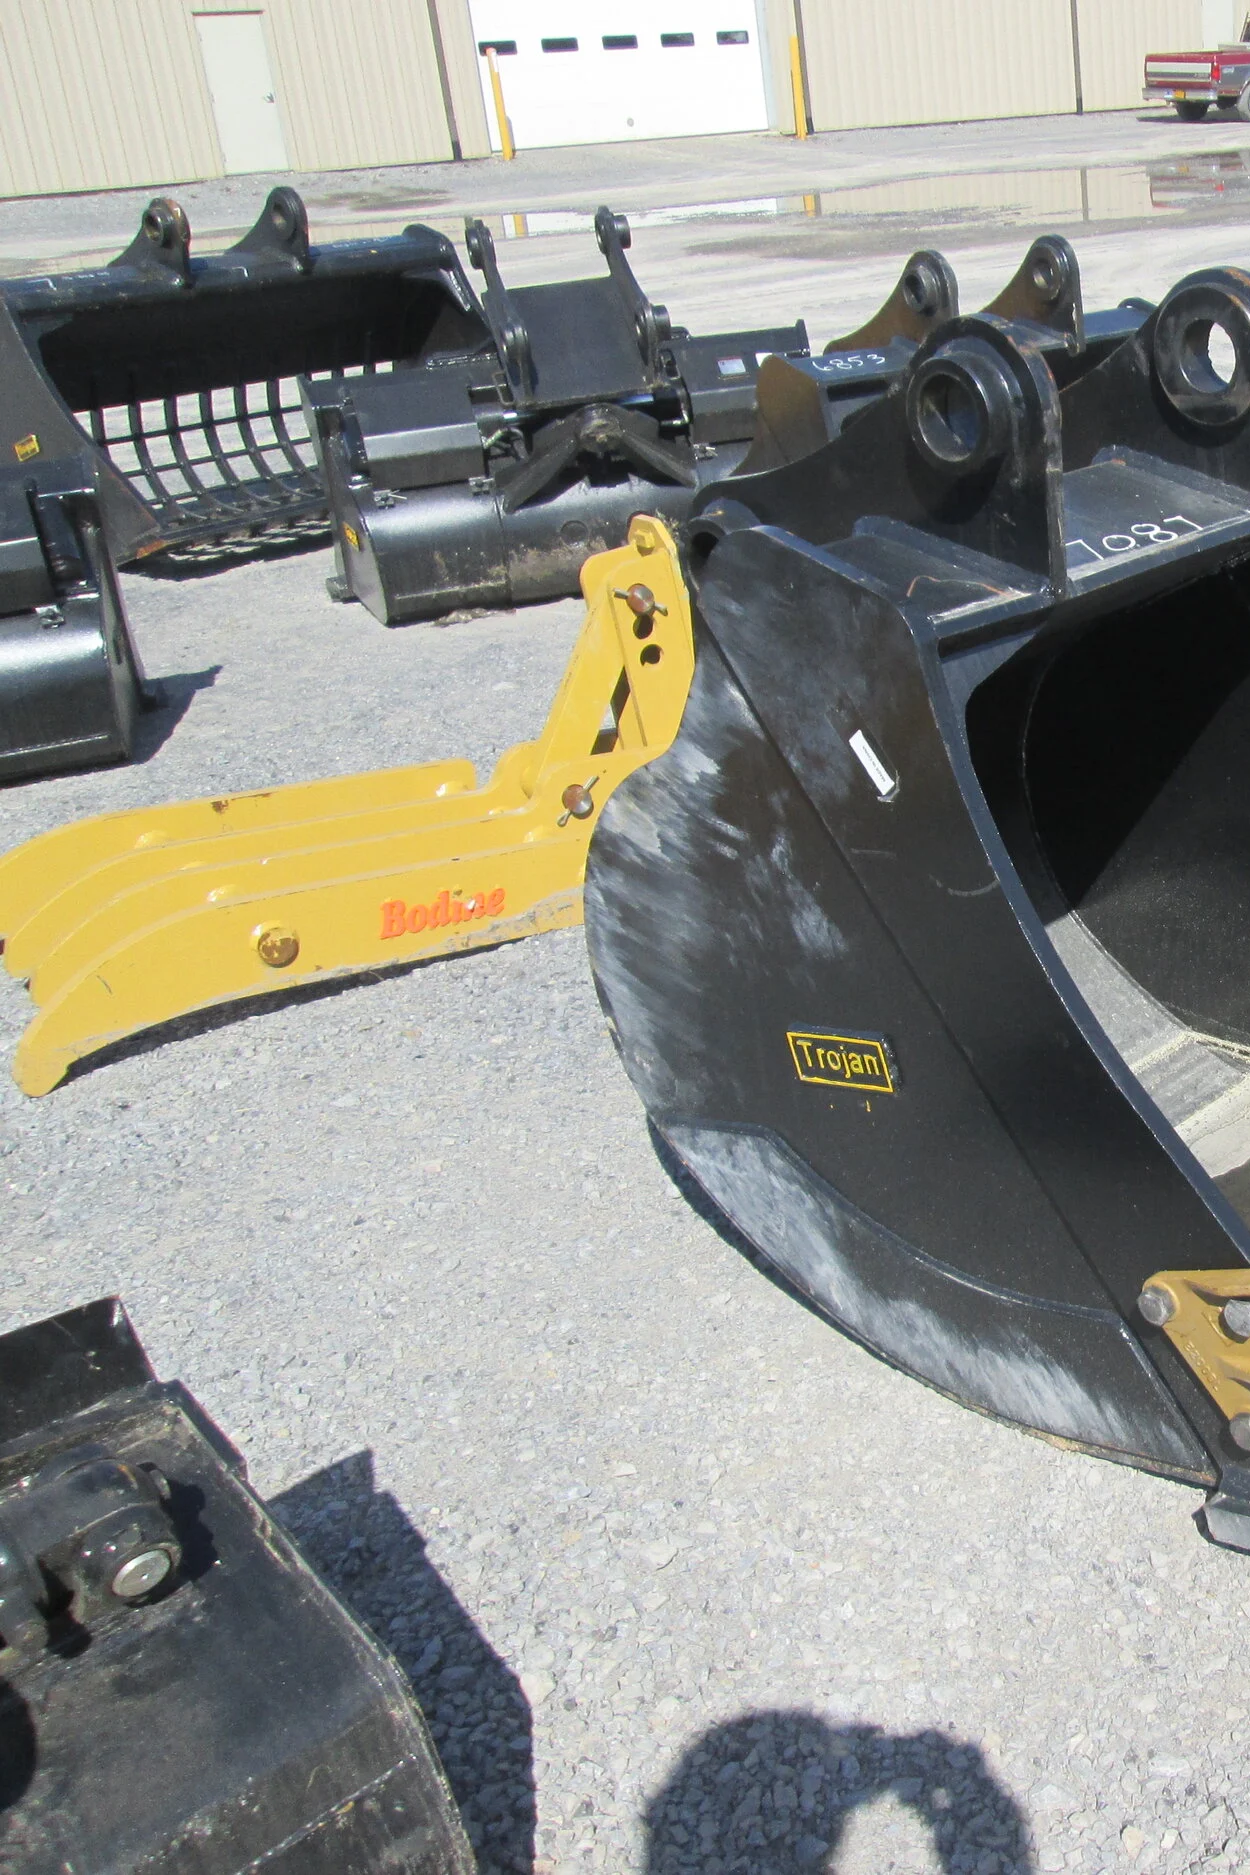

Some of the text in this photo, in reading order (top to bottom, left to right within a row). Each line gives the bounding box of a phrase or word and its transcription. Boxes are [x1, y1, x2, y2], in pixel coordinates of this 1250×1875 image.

[811, 353, 886, 372] 6853
[1065, 515, 1203, 560] 7087
[380, 888, 506, 940] Bodine
[795, 1039, 880, 1079] Trojan
